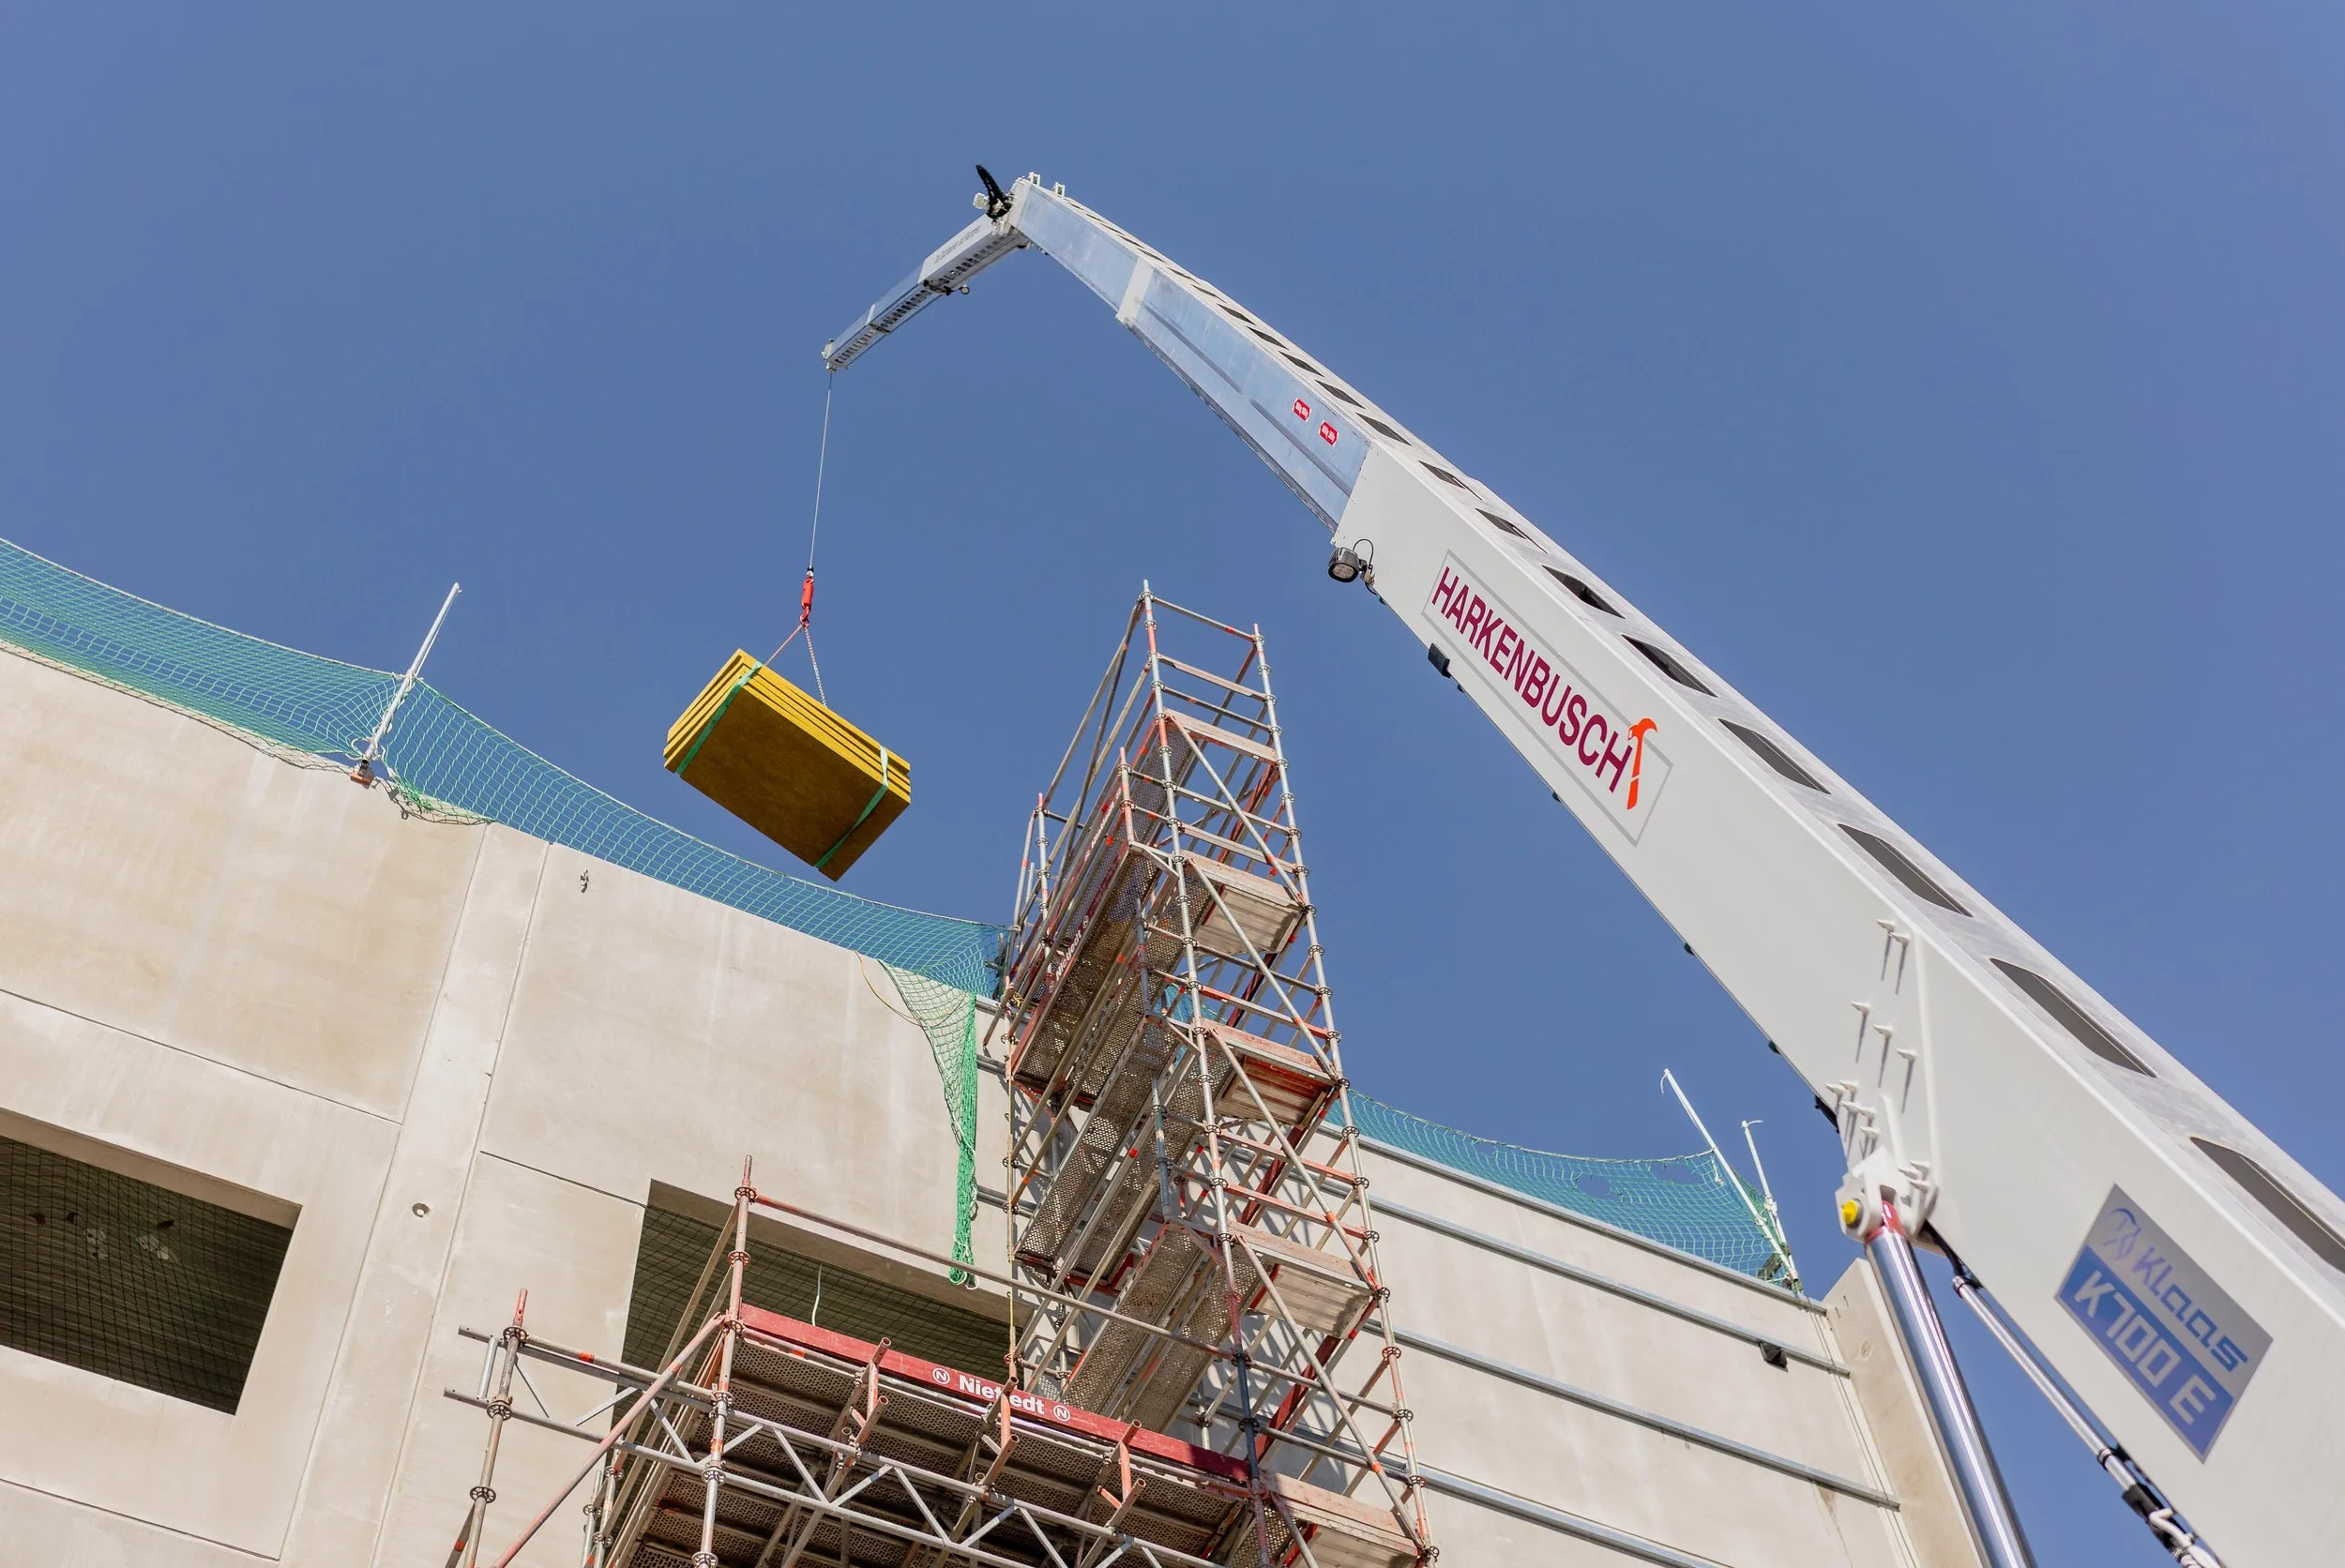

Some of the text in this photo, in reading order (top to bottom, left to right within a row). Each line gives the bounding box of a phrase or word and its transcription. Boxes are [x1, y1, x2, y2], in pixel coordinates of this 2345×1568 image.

[1431, 566, 1633, 792] HARKENBUSCH
[959, 1374, 1045, 1415] Nietedt
[2074, 1270, 2216, 1425] K700 E
